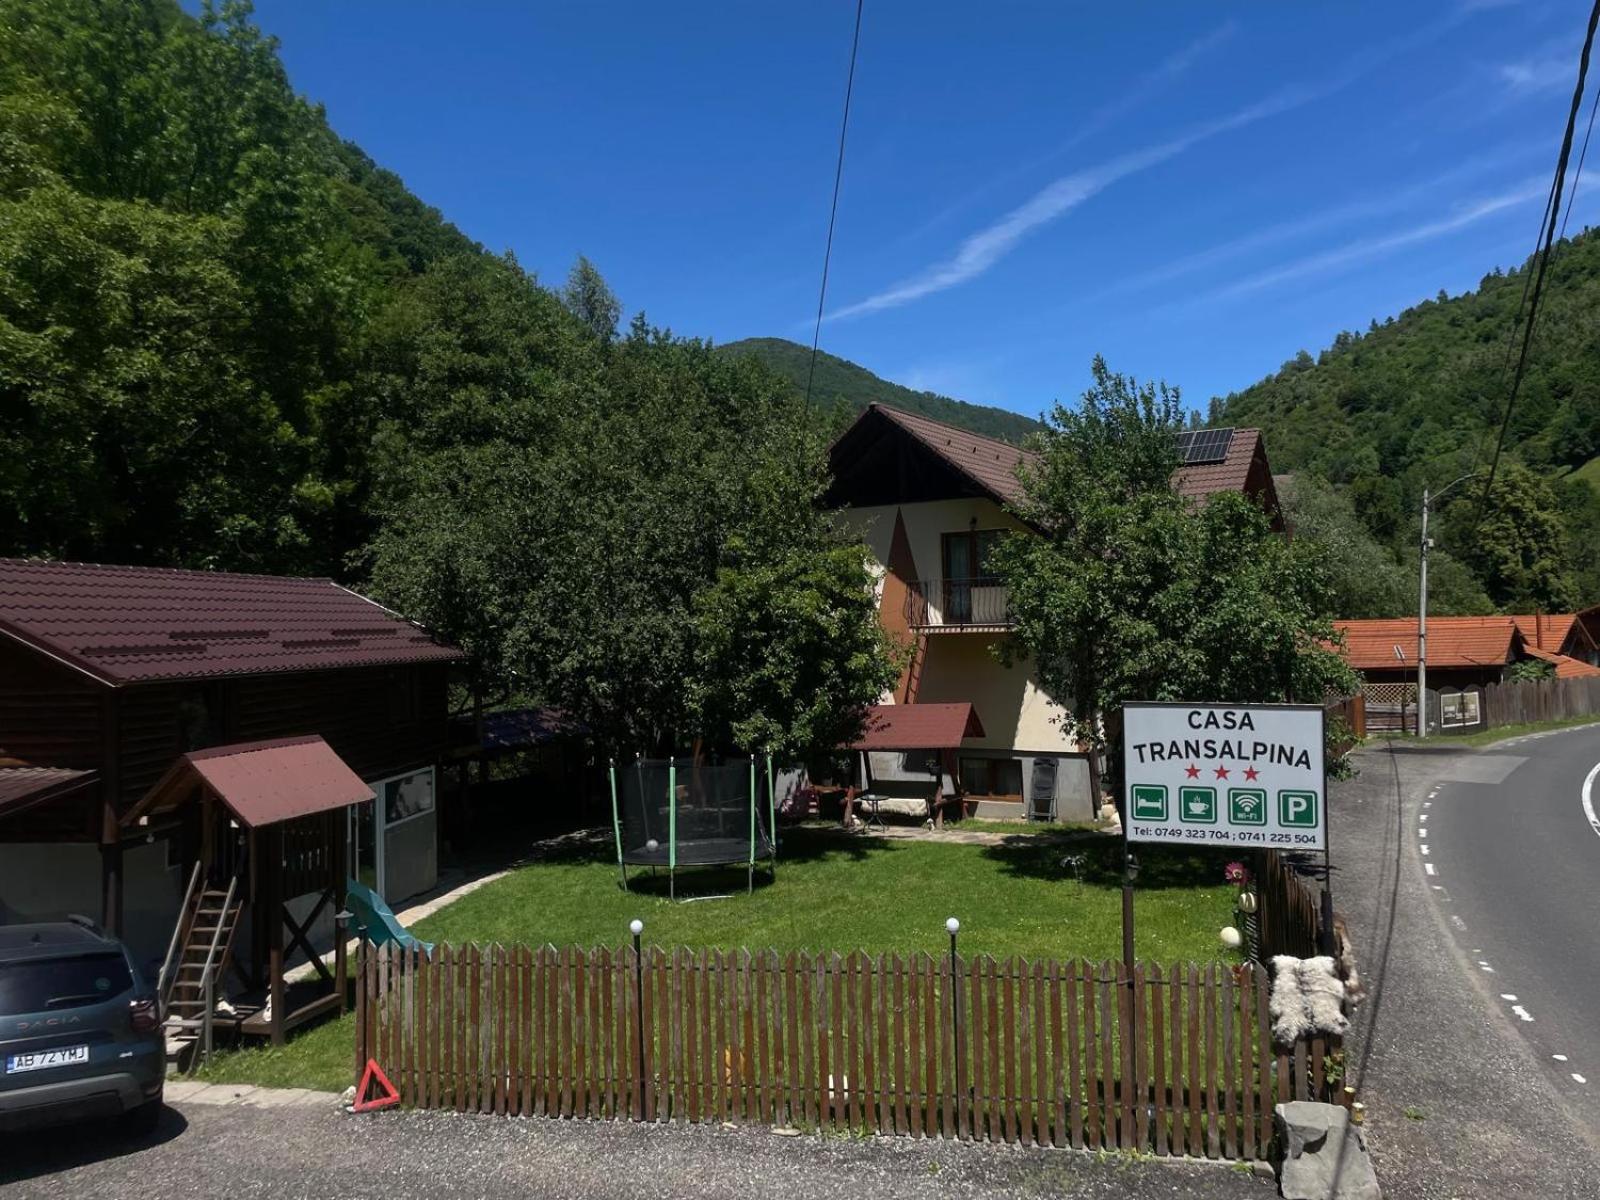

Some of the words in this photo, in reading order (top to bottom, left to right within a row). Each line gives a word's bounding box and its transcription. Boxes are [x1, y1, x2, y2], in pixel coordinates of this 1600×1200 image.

[1188, 710, 1255, 731] CASA
[1133, 739, 1311, 770] TRANSALPINA
[1288, 797, 1308, 821] P
[1133, 827, 1152, 836] Tel:
[1154, 828, 1182, 838] 0749
[1185, 829, 1206, 840] 323
[1209, 830, 1230, 841] 704
[1238, 832, 1266, 842] 0741
[1270, 833, 1292, 843] 225
[1294, 834, 1316, 844] 504
[17, 1015, 80, 1031] DACIA
[16, 1055, 34, 1068] AB
[41, 1052, 56, 1063] 72
[59, 1048, 84, 1061] YMJ
